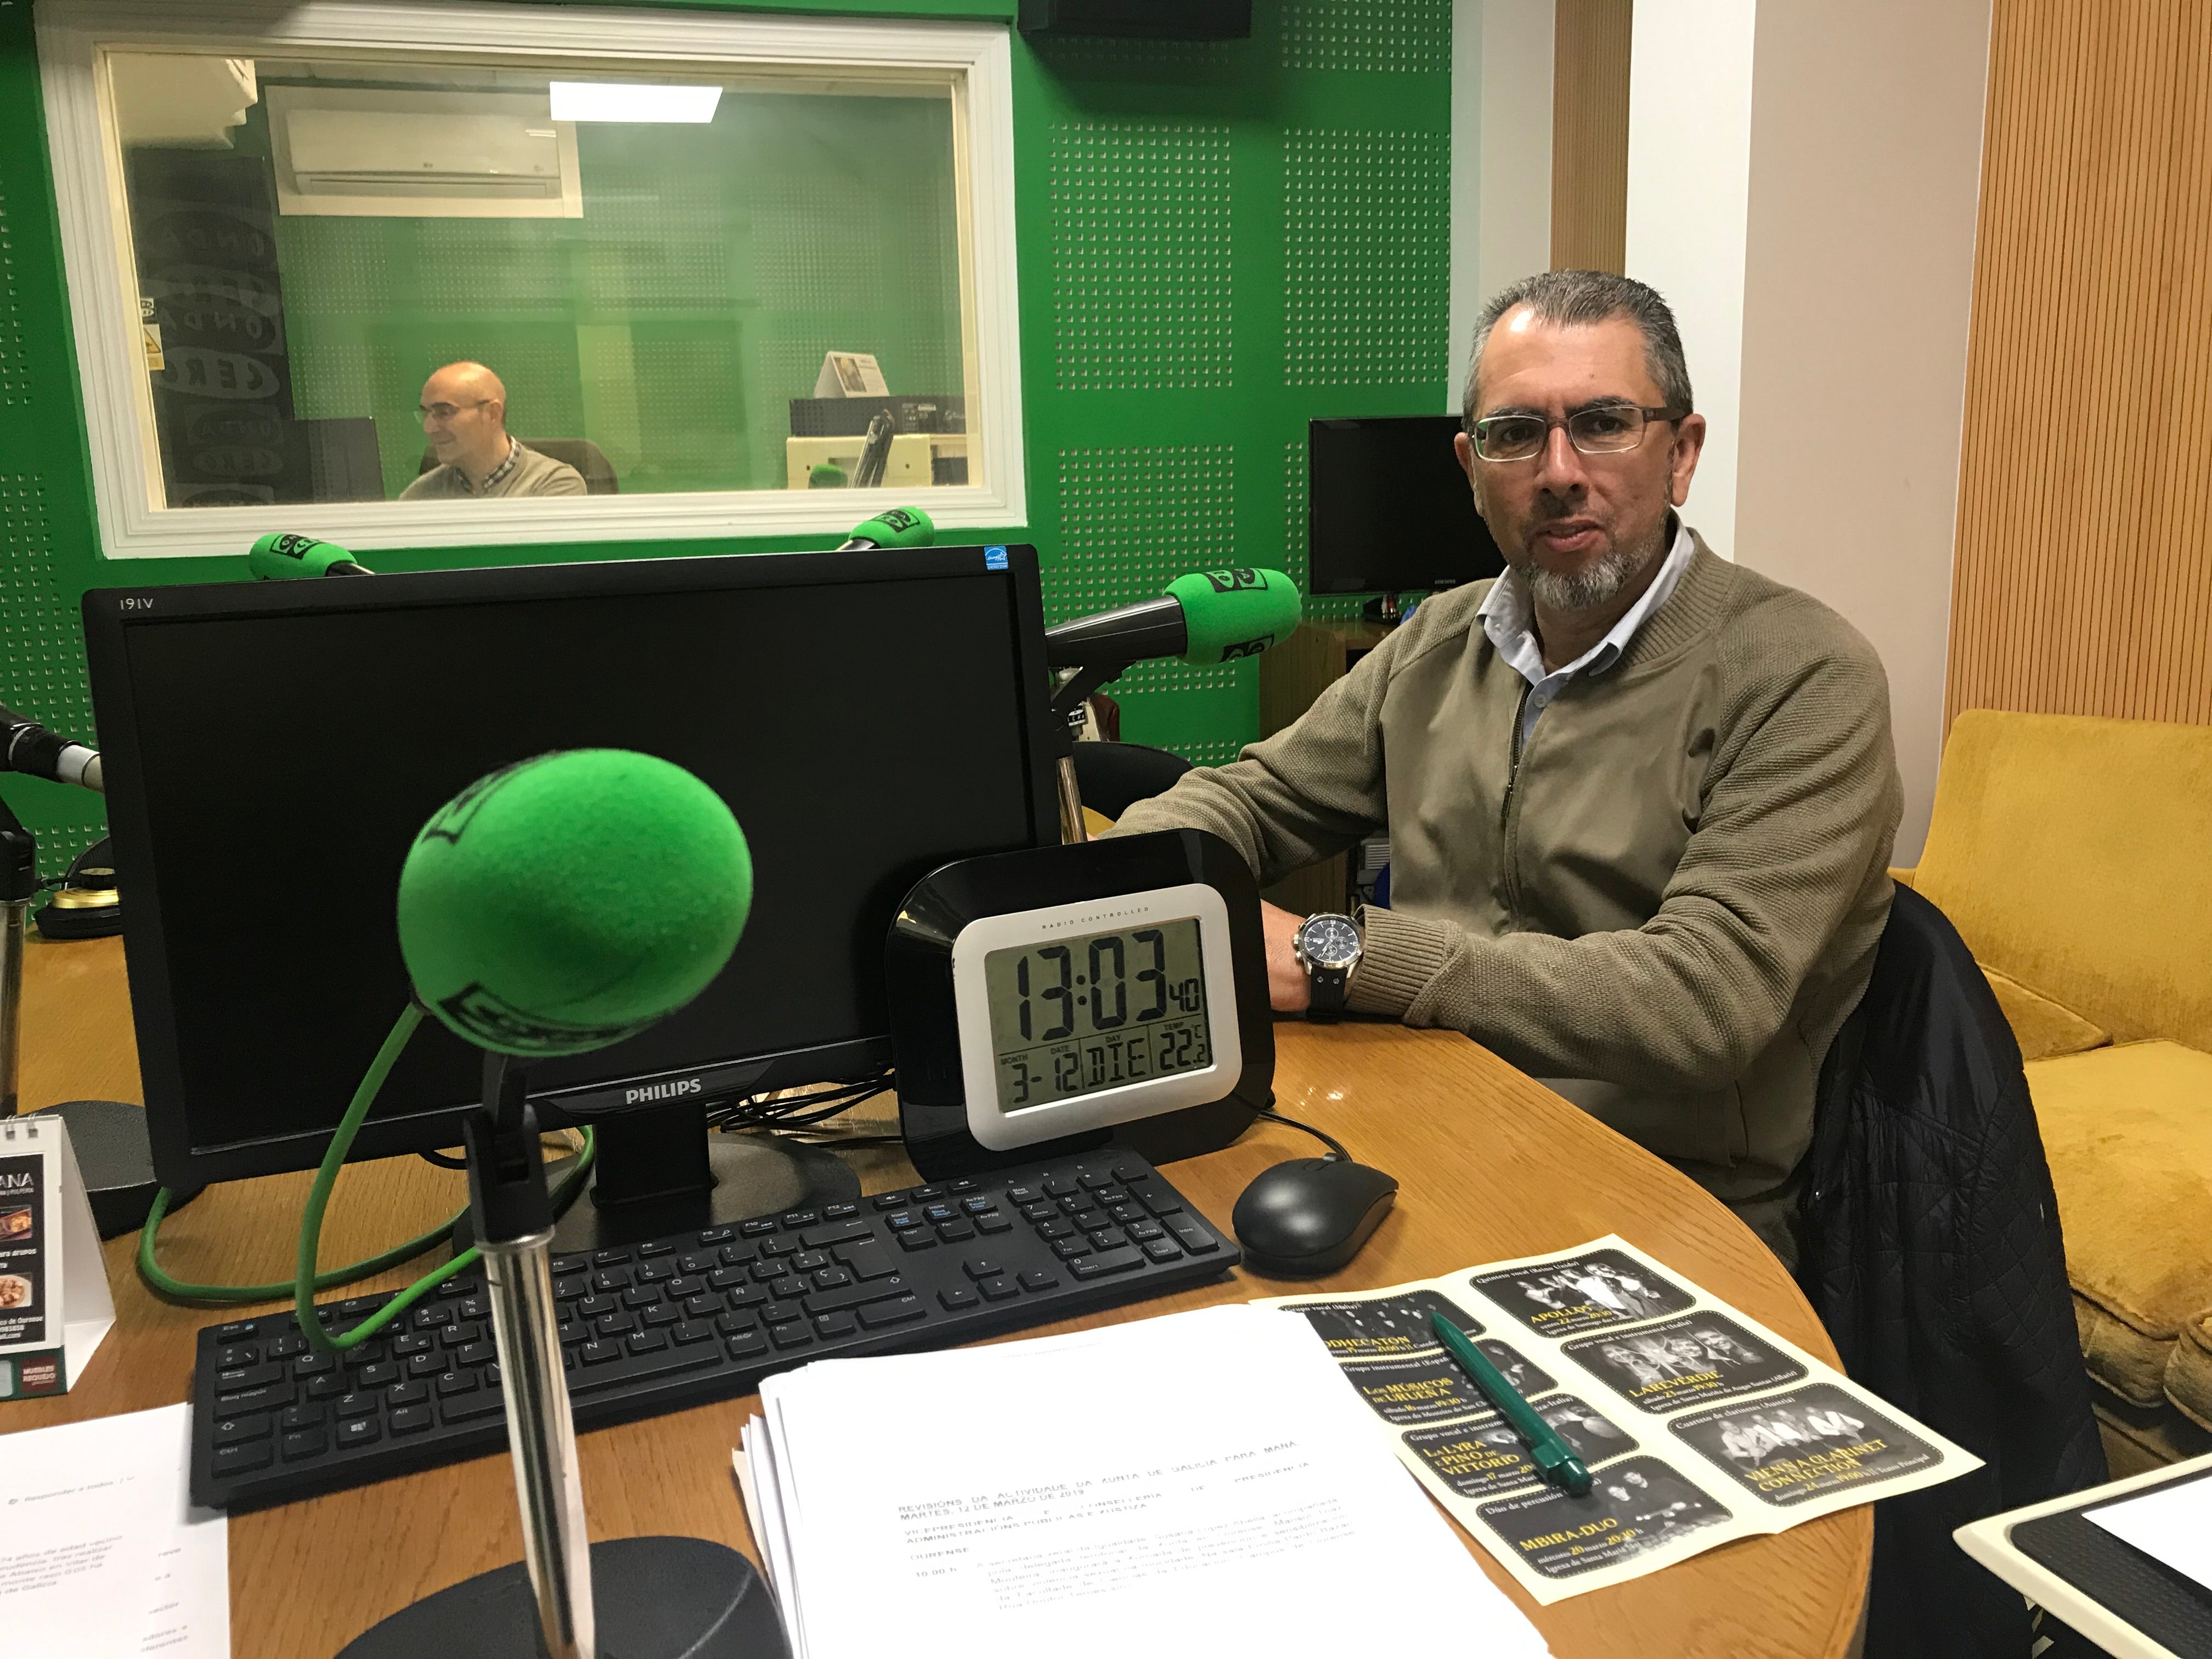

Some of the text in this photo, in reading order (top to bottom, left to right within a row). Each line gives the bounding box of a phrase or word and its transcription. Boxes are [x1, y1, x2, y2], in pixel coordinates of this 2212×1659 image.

[1042, 906, 1150, 929] RADIO CONTROLLED
[1017, 929, 1168, 1041] 13:03
[1169, 978, 1200, 1012] 40
[1163, 1022, 1184, 1031] TEMP
[1105, 1034, 1121, 1043] DAY
[1050, 1045, 1070, 1054] DATE
[1000, 1053, 1029, 1065] MONTH
[1086, 1037, 1147, 1088] DIE
[1054, 1052, 1079, 1092] 12
[625, 1078, 702, 1105] PHILIPS
[1530, 1304, 1593, 1325] APOLLO5
[586, 1341, 598, 1350] N
[1567, 1340, 1594, 1351] Grupo
[1594, 1336, 1615, 1345] vocal
[1344, 1364, 1370, 1373] Grupo
[22, 1373, 55, 1382] REQUEJO
[315, 1376, 326, 1384] A
[394, 1383, 405, 1392] X
[1385, 1377, 1454, 1394] MÚSICOS
[343, 1394, 354, 1403] Z
[1675, 1415, 1712, 1429] Cuarteto
[1712, 1411, 1724, 1419] de
[1409, 1433, 1439, 1442] Grupo
[1438, 1428, 1463, 1437] vocal
[1442, 1440, 1487, 1454] LYRA
[1441, 1451, 1483, 1465] PINO
[1441, 1454, 1520, 1475] VITTORIO
[1743, 1459, 1810, 1481] VIENNA
[1758, 1458, 1863, 1492] CONNECTION
[1457, 1476, 1489, 1487] domingo
[898, 1498, 963, 1513] REVISIÓNS
[1520, 1492, 1564, 1509] percusión
[1519, 1517, 1618, 1551] MBIRA-DUO
[1580, 1553, 1604, 1564] Santa
